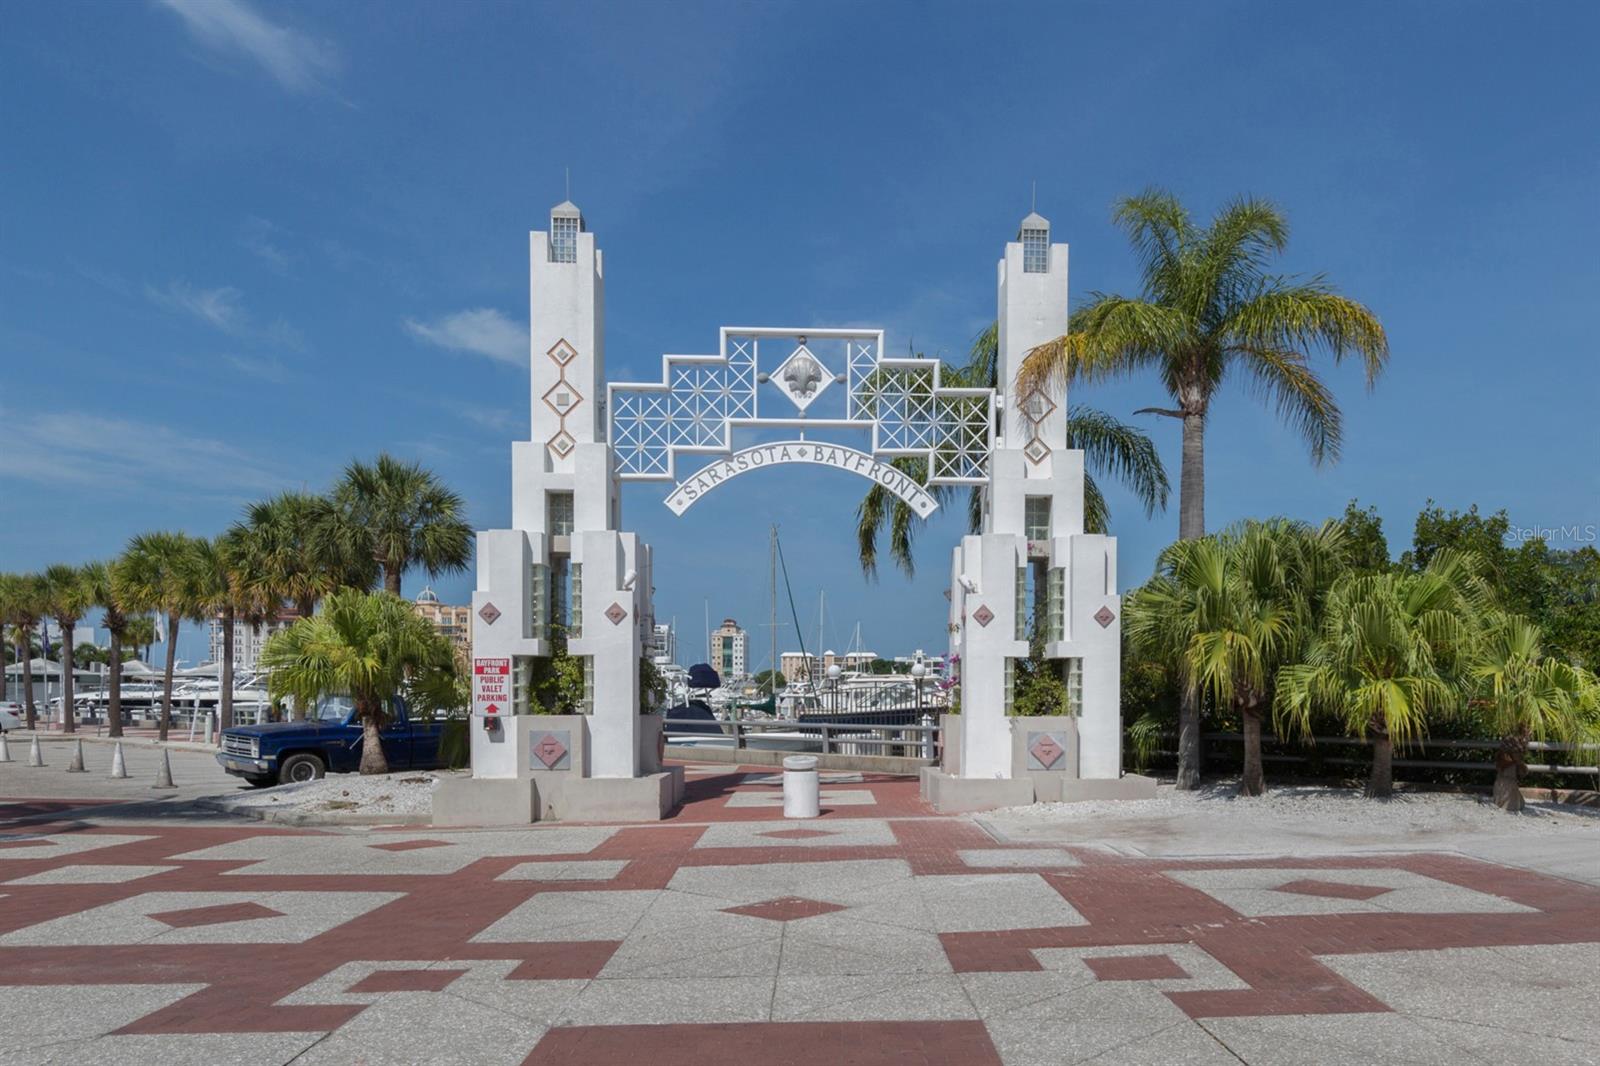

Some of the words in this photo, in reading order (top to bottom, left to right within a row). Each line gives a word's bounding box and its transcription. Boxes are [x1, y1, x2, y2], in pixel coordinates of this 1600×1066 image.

[684, 446, 793, 500] SARASOTA
[813, 446, 922, 502] BAYFRONT
[476, 659, 508, 667] BAYFRONT
[477, 694, 508, 702] PARKING
